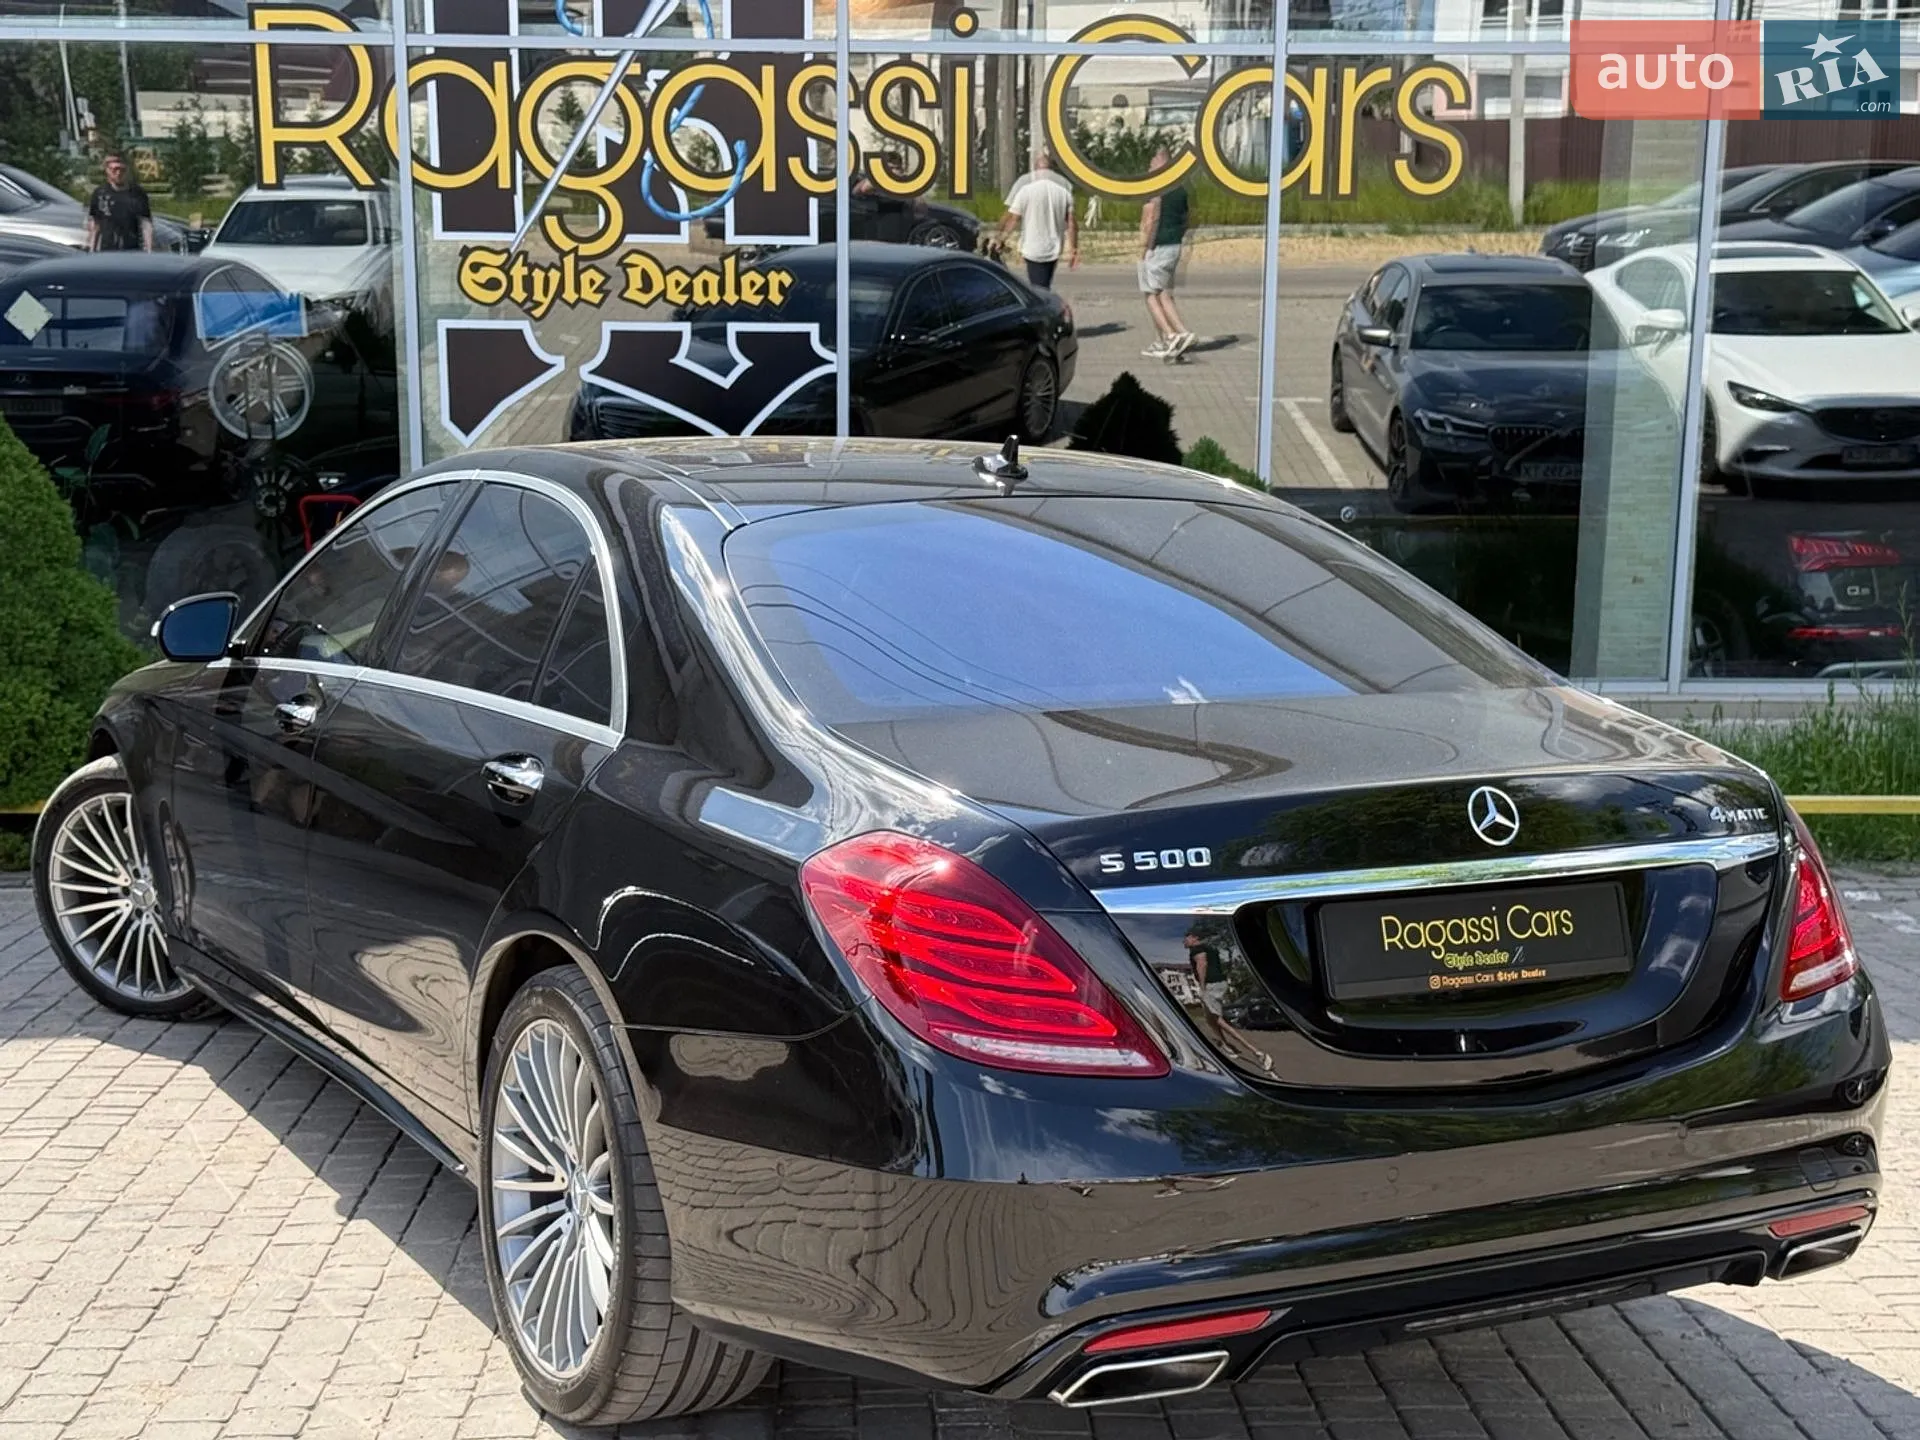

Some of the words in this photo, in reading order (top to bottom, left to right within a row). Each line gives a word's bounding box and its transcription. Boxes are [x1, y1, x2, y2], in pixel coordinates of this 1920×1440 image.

[248, 4, 976, 256] Ragassi
[1041, 13, 1471, 199] Cars
[458, 246, 612, 321] Style
[616, 249, 795, 308] Dealer
[1709, 806, 1769, 822] 4MATIC
[1100, 852, 1125, 873] S
[1133, 846, 1212, 871] 500
[1380, 905, 1500, 960] Ragassi
[1506, 904, 1574, 939] Cars
